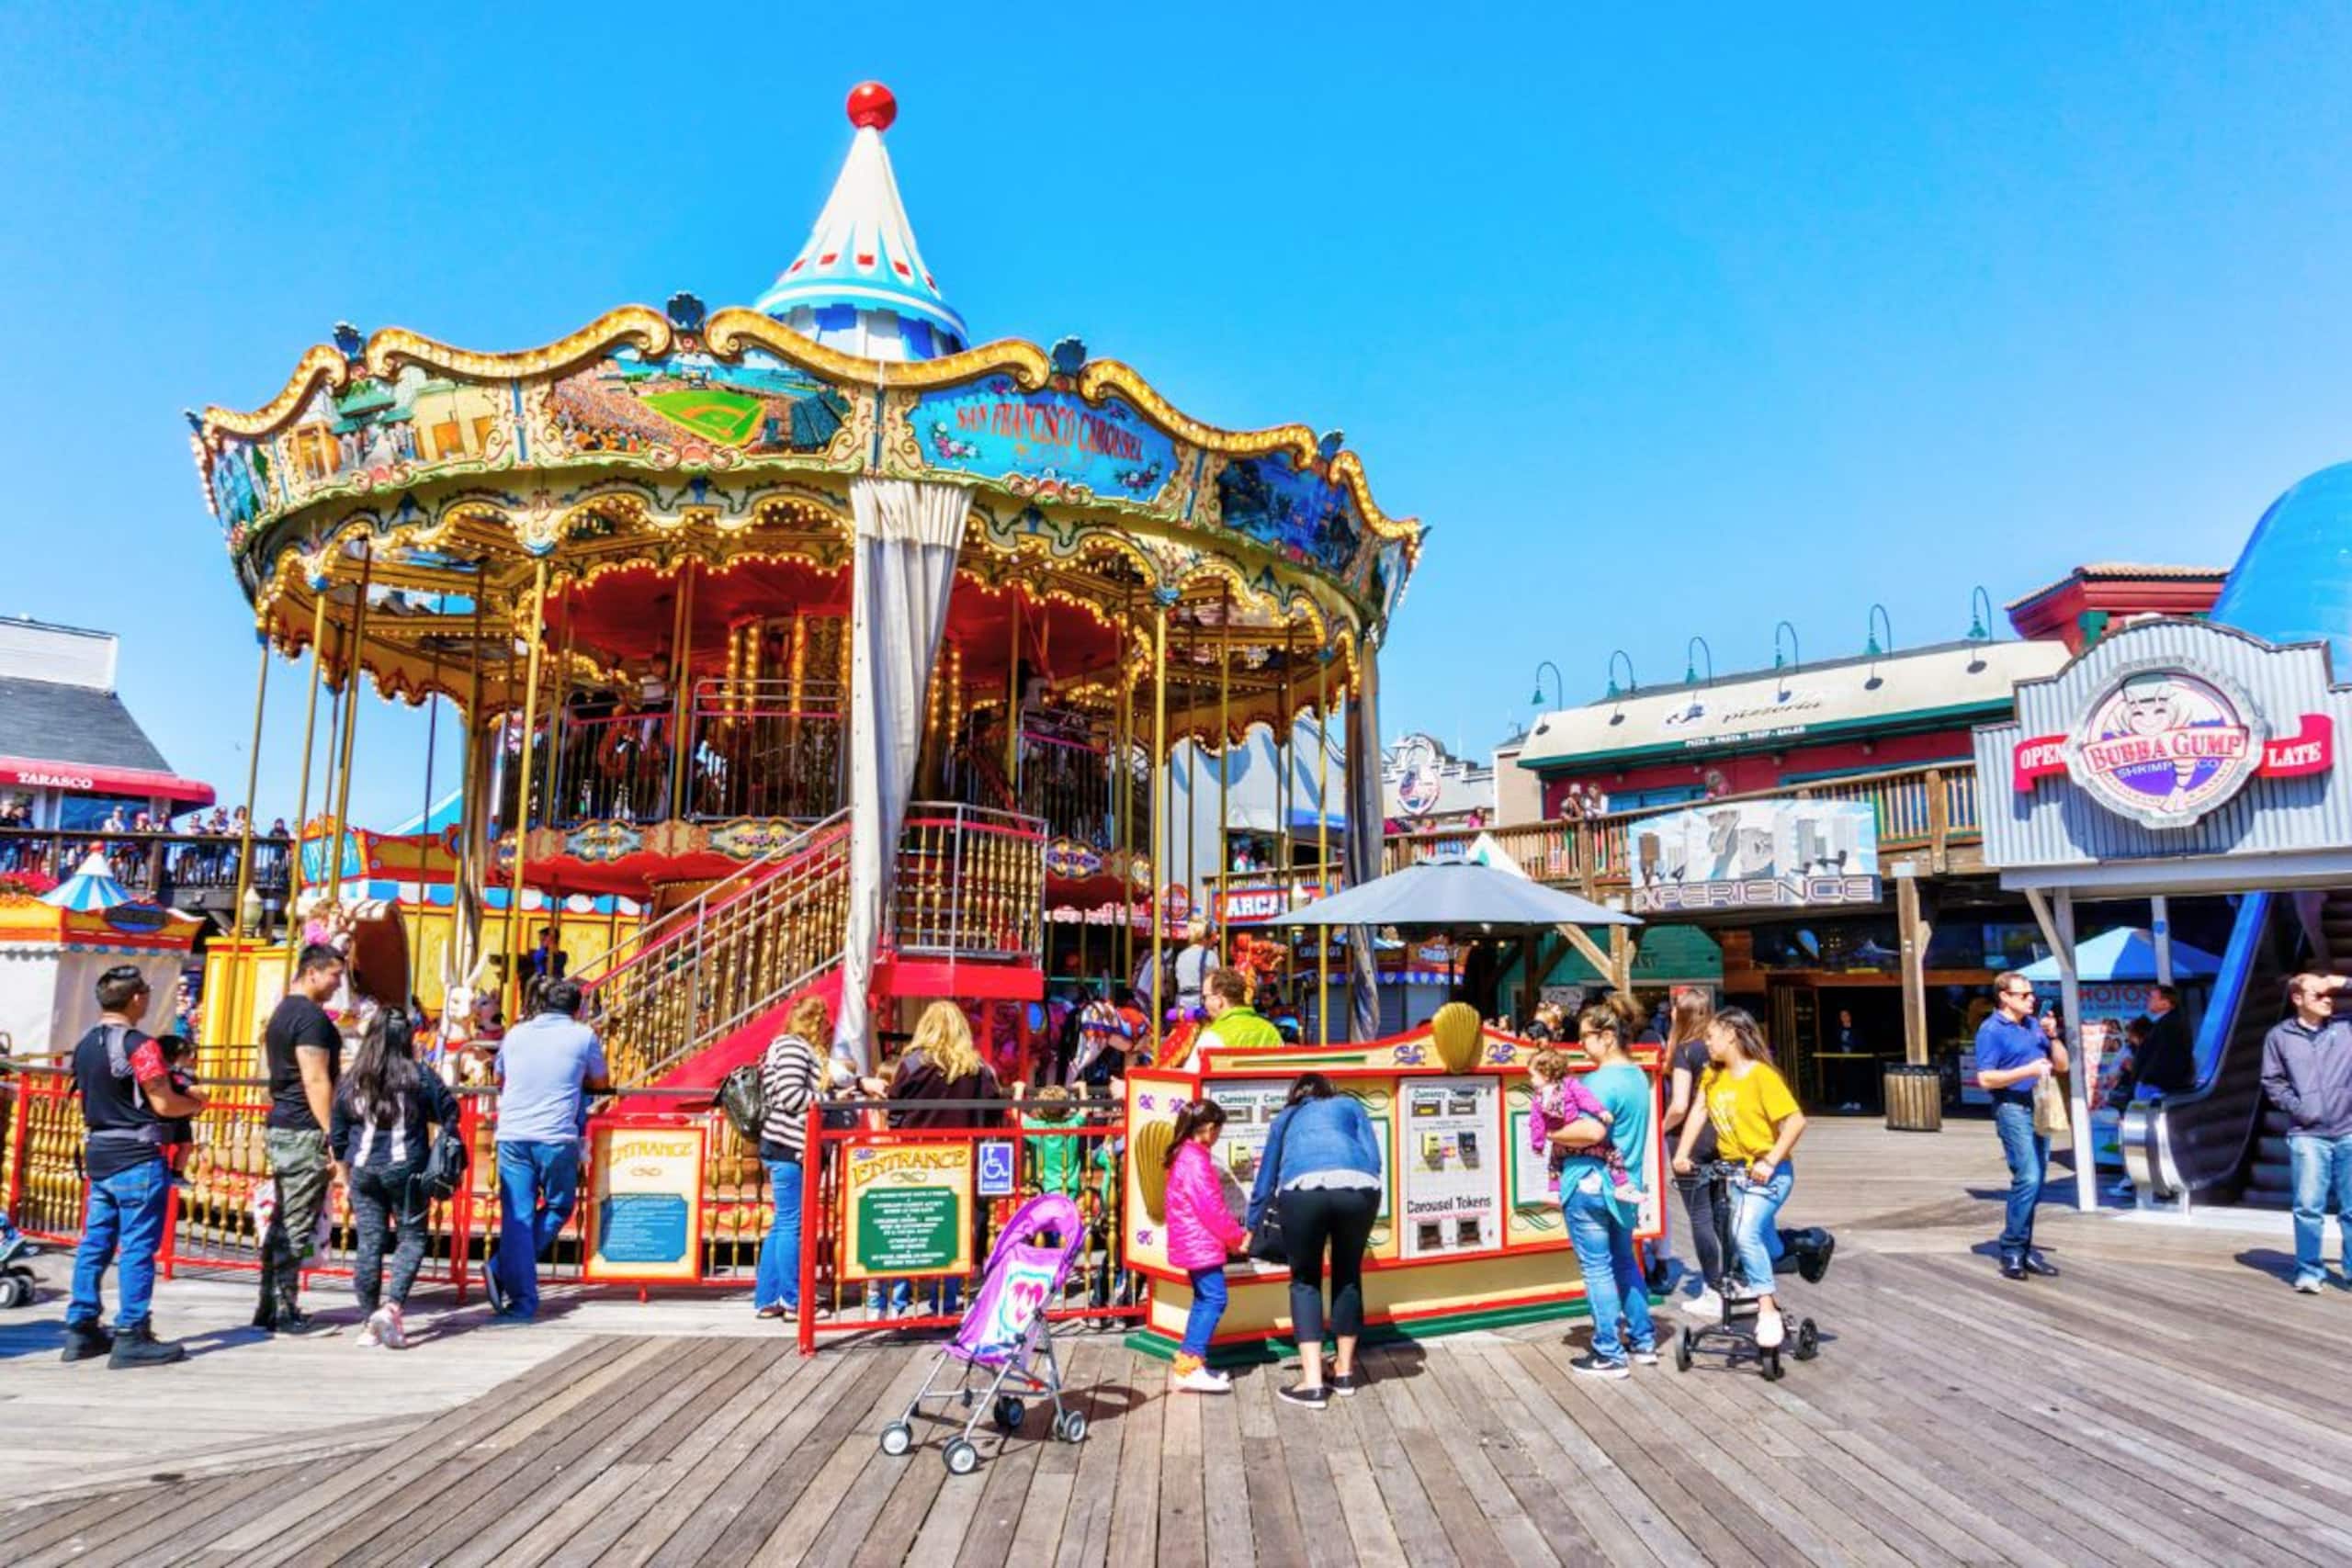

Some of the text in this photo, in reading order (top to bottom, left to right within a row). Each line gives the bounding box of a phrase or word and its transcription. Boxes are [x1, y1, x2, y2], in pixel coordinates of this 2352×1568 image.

[956, 402, 1143, 462] SAN FRANCISCO CAROUSEL
[2089, 732, 2244, 769] BUBBA GUMP
[2268, 741, 2322, 768] LATE
[17, 772, 94, 789] TARASCO
[853, 1150, 967, 1187] ENTRANCE
[1407, 1195, 1492, 1213] Carousel Tokens
